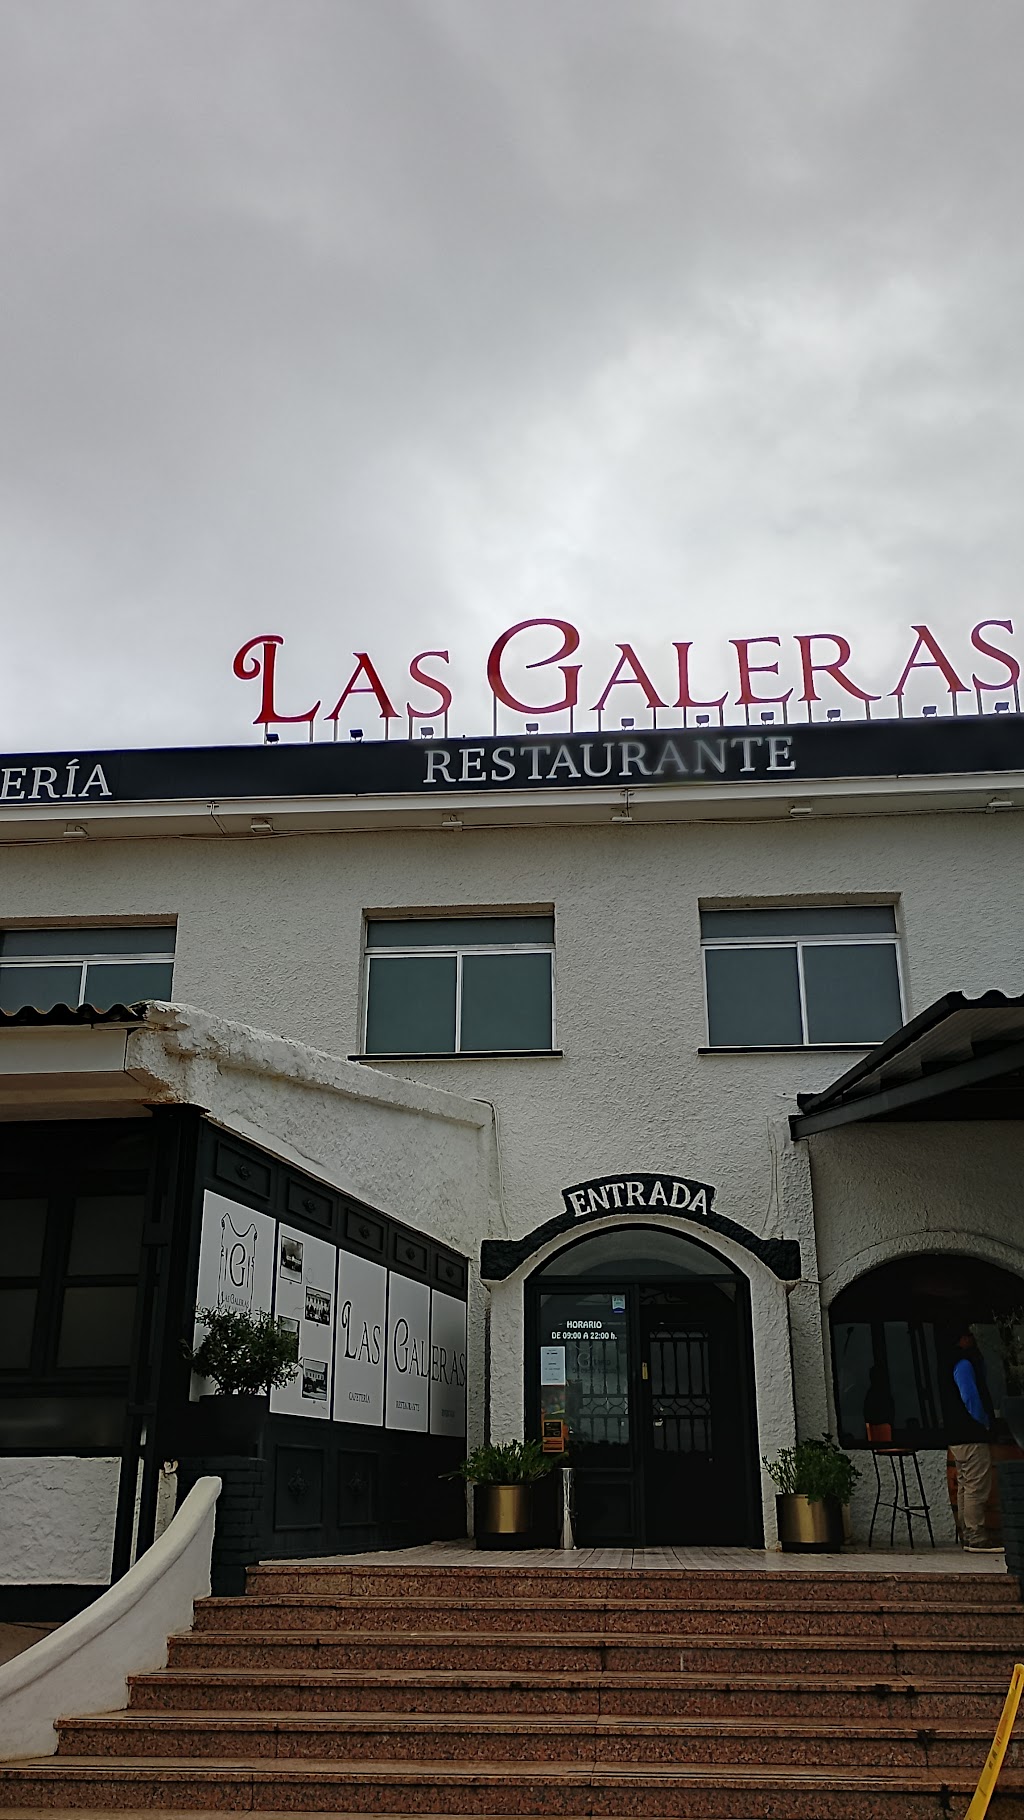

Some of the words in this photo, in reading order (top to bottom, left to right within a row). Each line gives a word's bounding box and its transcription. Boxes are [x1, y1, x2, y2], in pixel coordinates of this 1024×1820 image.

[233, 634, 452, 725] LAS
[487, 618, 1021, 715] GALERAS
[423, 735, 797, 785] RESTAURANTE
[567, 1181, 708, 1217] ENTRADA
[341, 1300, 381, 1365] LAS
[393, 1318, 466, 1387] GALERAS
[566, 1321, 602, 1329] HORARIO
